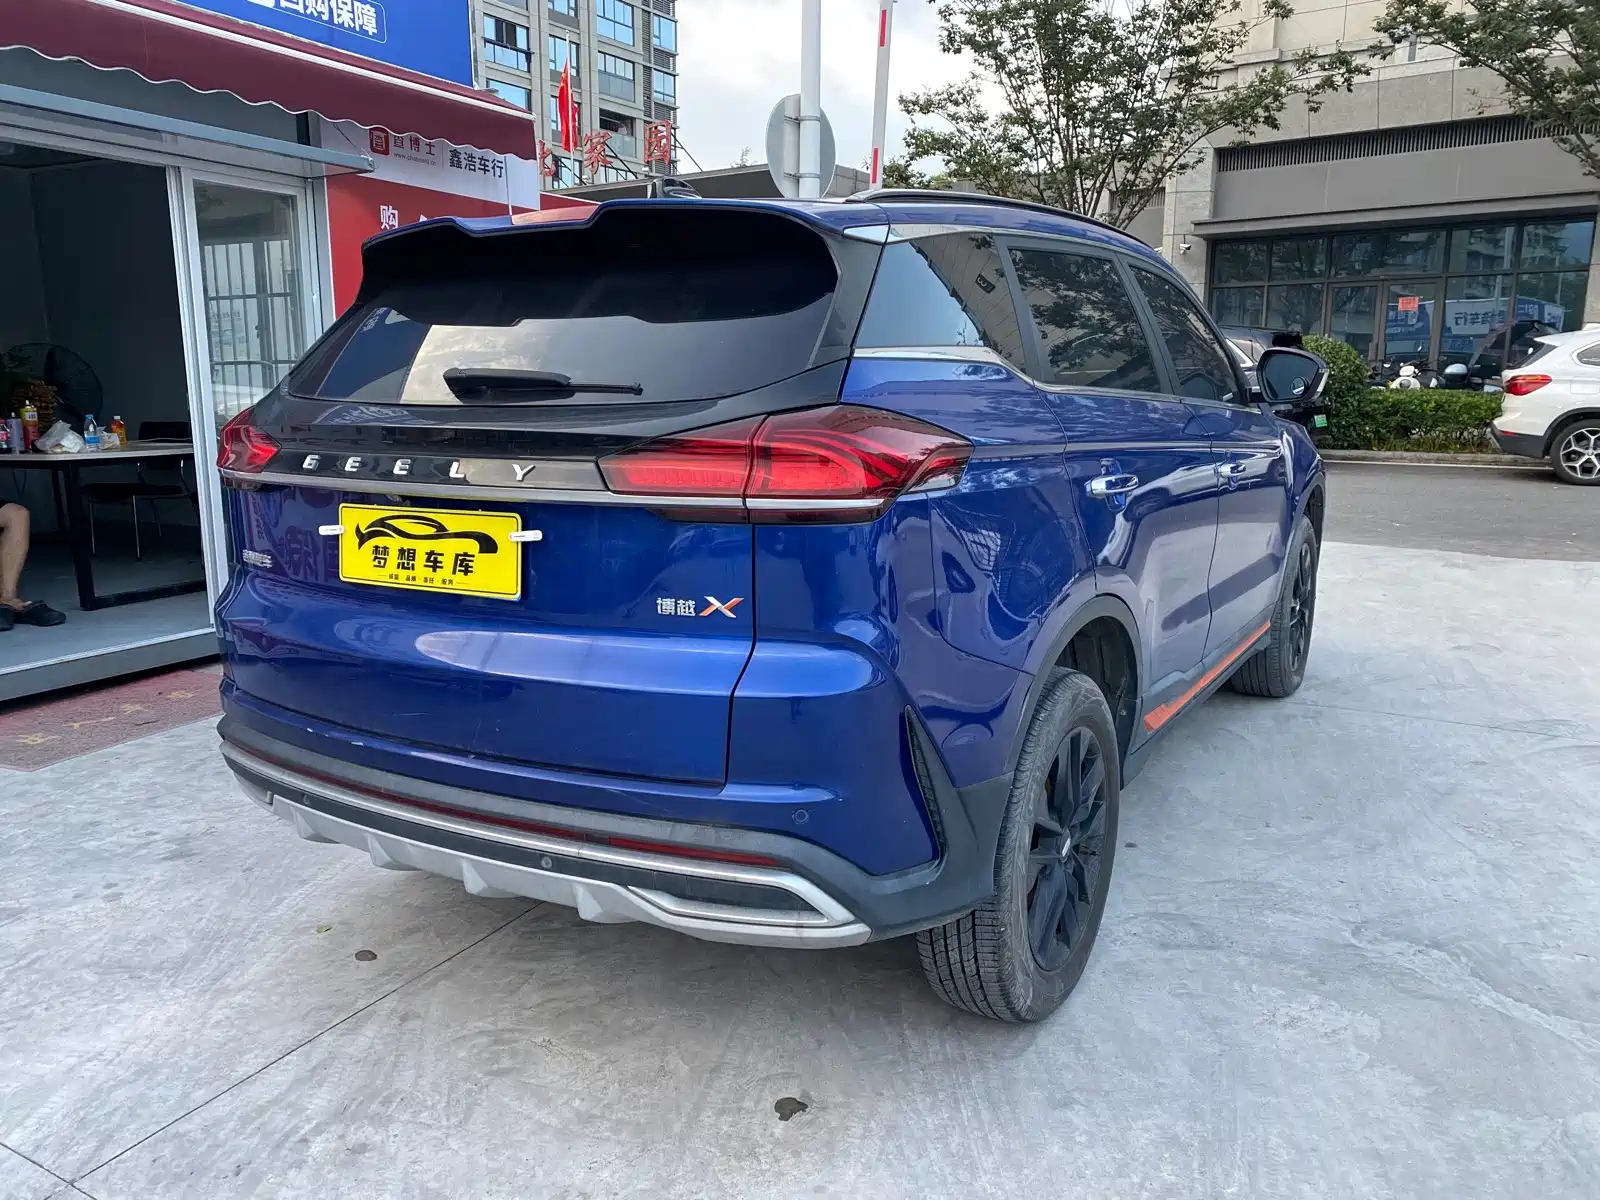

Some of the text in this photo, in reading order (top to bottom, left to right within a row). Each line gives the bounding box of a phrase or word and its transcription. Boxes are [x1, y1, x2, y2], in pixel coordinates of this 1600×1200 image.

[449, 149, 504, 178] 鑫浩车行
[302, 454, 536, 481] GEELY
[371, 545, 476, 576] 梦想车库
[656, 595, 744, 618] 博越 X
